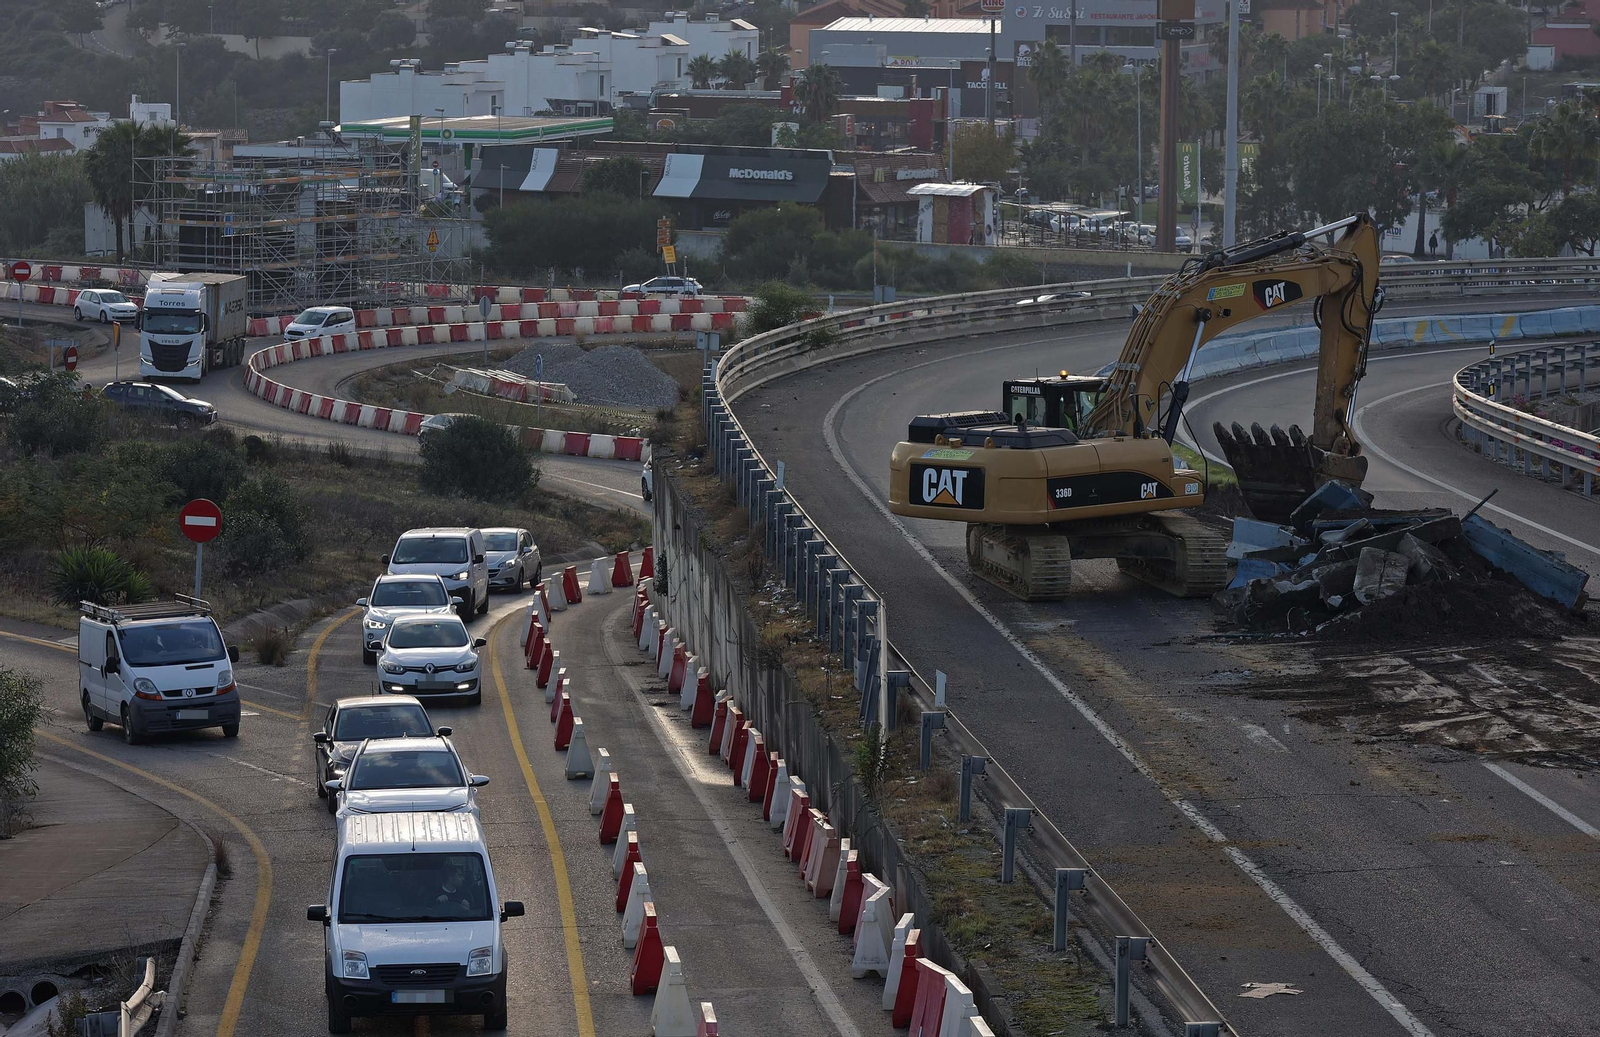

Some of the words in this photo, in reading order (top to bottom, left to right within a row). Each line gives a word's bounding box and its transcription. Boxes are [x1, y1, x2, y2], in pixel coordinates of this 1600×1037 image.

[1090, 12, 1134, 20] RESTAURANTE
[967, 81, 986, 89] TACO
[729, 168, 793, 181] McDonald's
[896, 170, 939, 181] McDonald's
[1265, 281, 1286, 308] CAT
[1010, 386, 1041, 395] CATERPILLAR
[923, 468, 968, 506] CAT
[1140, 482, 1158, 499] CAT
[1055, 488, 1072, 499] 336D
